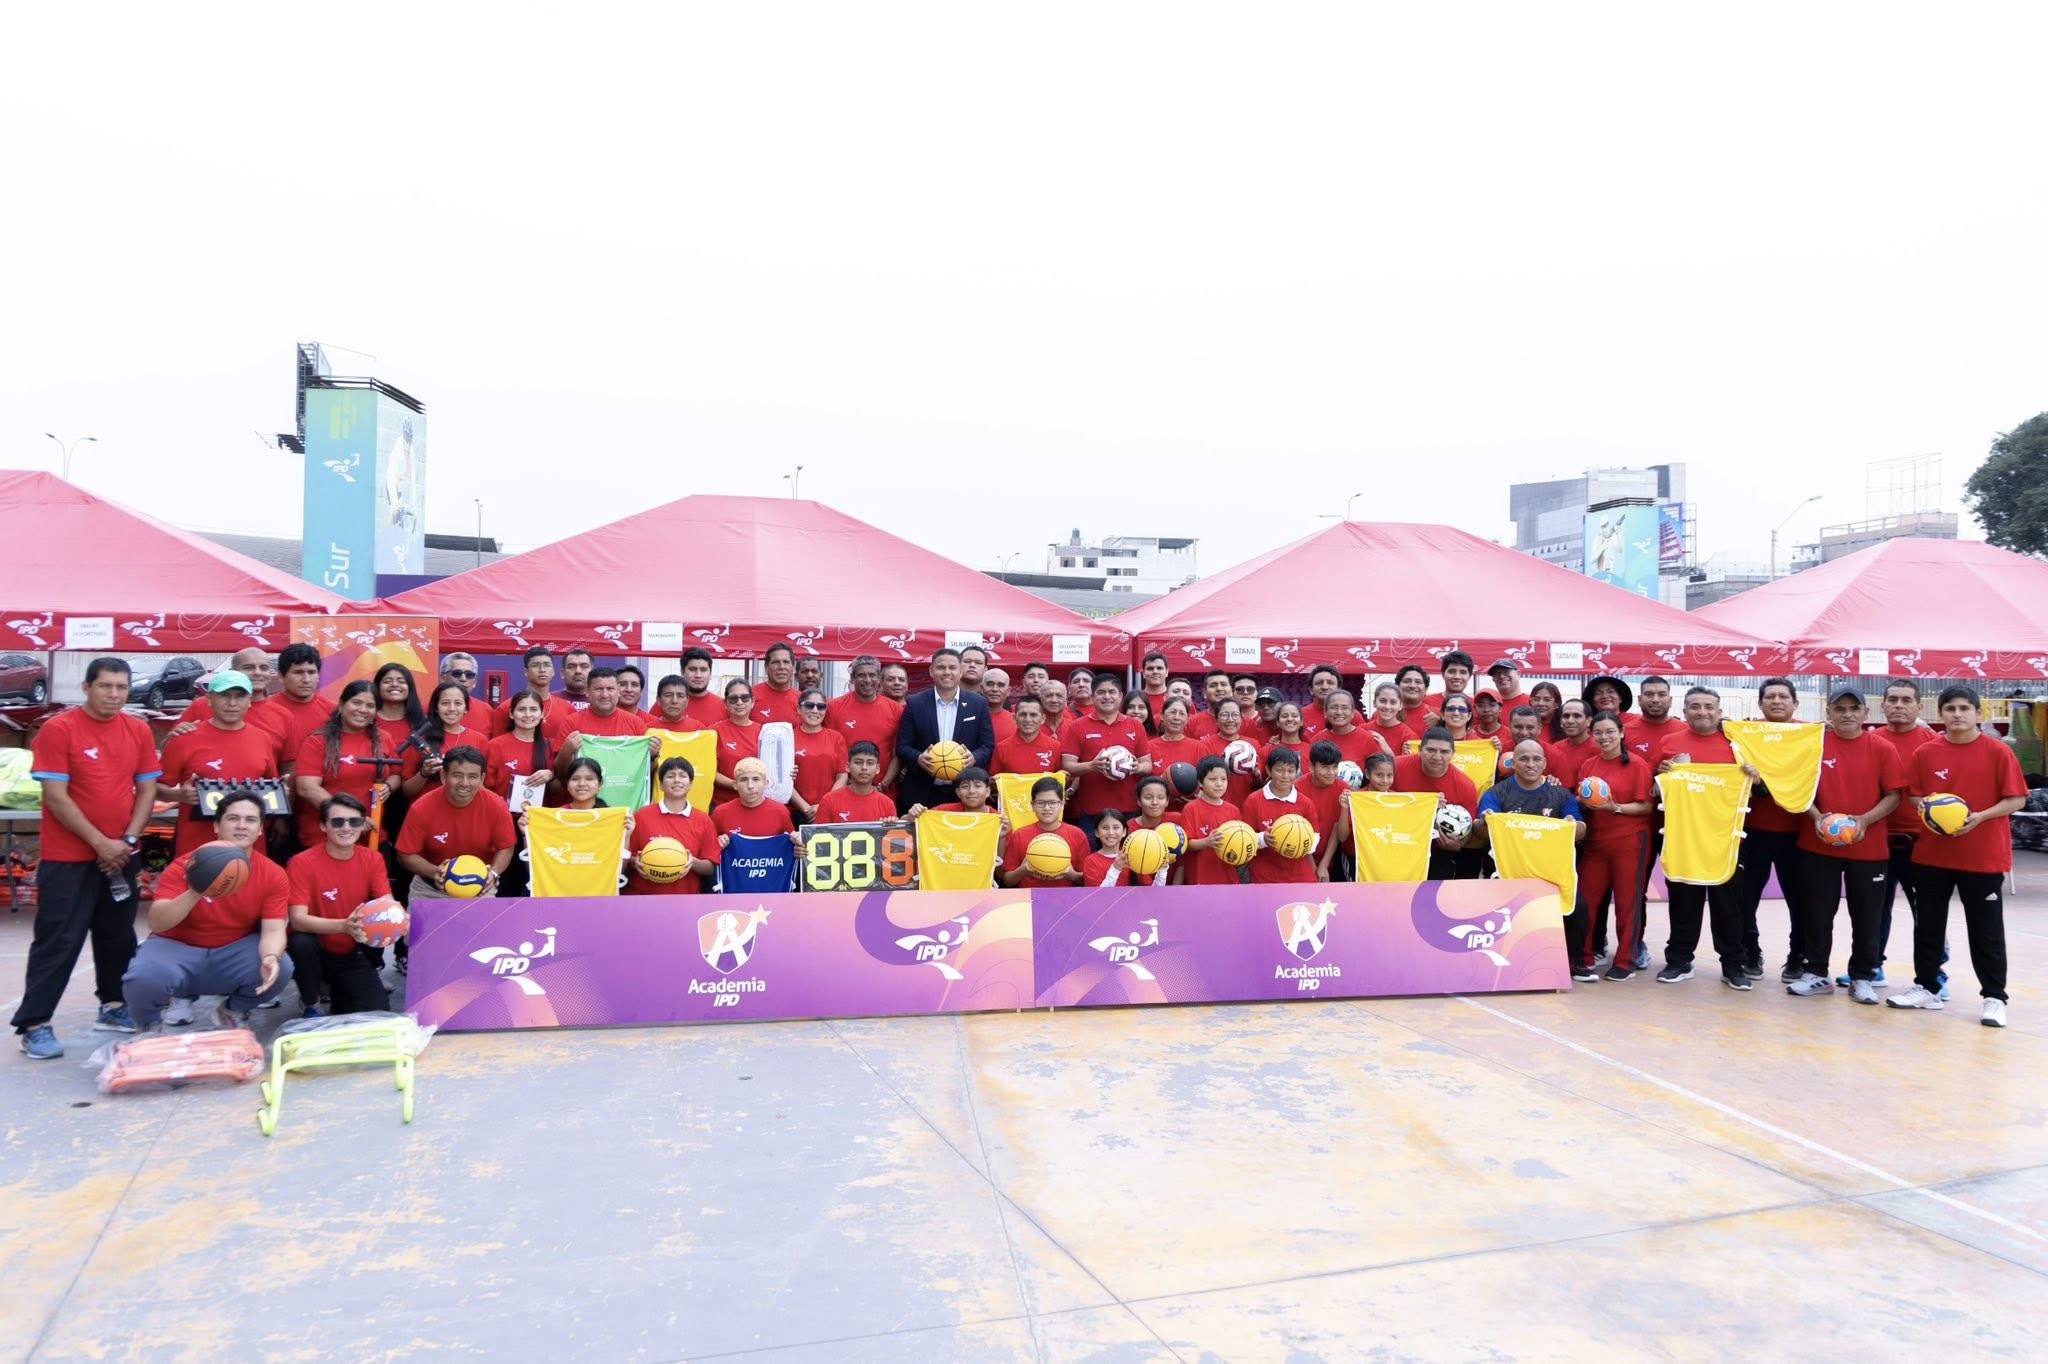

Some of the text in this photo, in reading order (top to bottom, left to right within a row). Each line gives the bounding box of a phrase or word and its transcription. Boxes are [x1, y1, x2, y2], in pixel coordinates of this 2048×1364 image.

[325, 542, 350, 589] Sur
[18, 625, 38, 635] IPD
[131, 626, 152, 636] IPD
[243, 625, 262, 635] IPD
[503, 626, 522, 635] IPD
[604, 630, 622, 640] IPD
[357, 636, 374, 645] IPD
[702, 633, 719, 643] IPD
[796, 637, 813, 646] IPD
[889, 640, 905, 649] IPD
[1190, 650, 1205, 658] IPD
[1274, 650, 1288, 659] IPD
[1356, 650, 1370, 659] IPD
[1513, 652, 1526, 660] IPD
[1588, 653, 1602, 661] IPD
[1662, 654, 1676, 662] IPD
[1735, 654, 1749, 663] IPD
[1763, 733, 1783, 742] IPD
[1687, 782, 1705, 792] IPD
[263, 791, 278, 809] 1
[1506, 819, 1561, 831] ACADEMIA
[1523, 830, 1542, 840] IPD
[731, 857, 784, 868] ACADEMIA
[749, 868, 767, 878] IPD
[1467, 934, 1495, 949] IPD
[916, 944, 947, 961] IPD
[1109, 946, 1139, 962] IPD
[492, 957, 530, 975] IPD
[1275, 964, 1341, 979] Academia
[687, 977, 766, 994] Academia
[1298, 979, 1320, 991] IPD
[713, 994, 739, 1007] IPD
